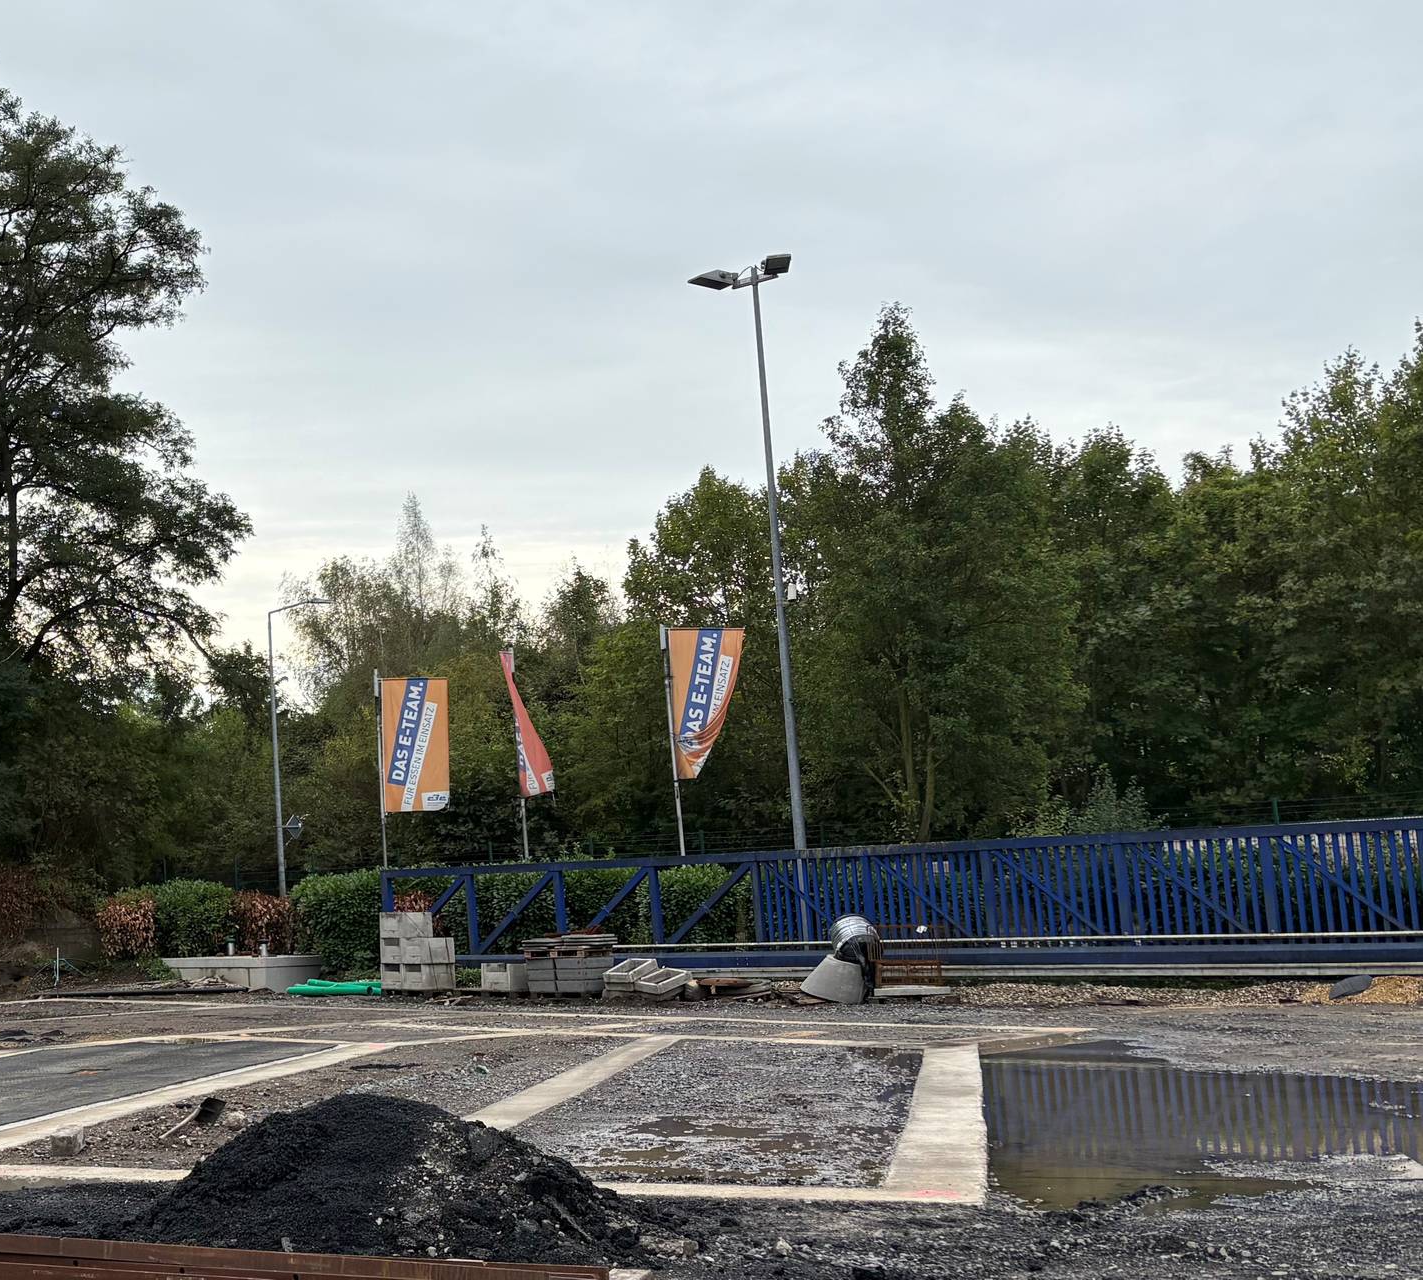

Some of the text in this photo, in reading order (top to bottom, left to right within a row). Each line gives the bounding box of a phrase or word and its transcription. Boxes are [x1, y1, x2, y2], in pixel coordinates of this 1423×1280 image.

[691, 633, 718, 705] E-TEAM.
[391, 681, 424, 781] DAS E-TEAM.
[409, 756, 423, 785] ESSEN
[416, 744, 425, 755] IM
